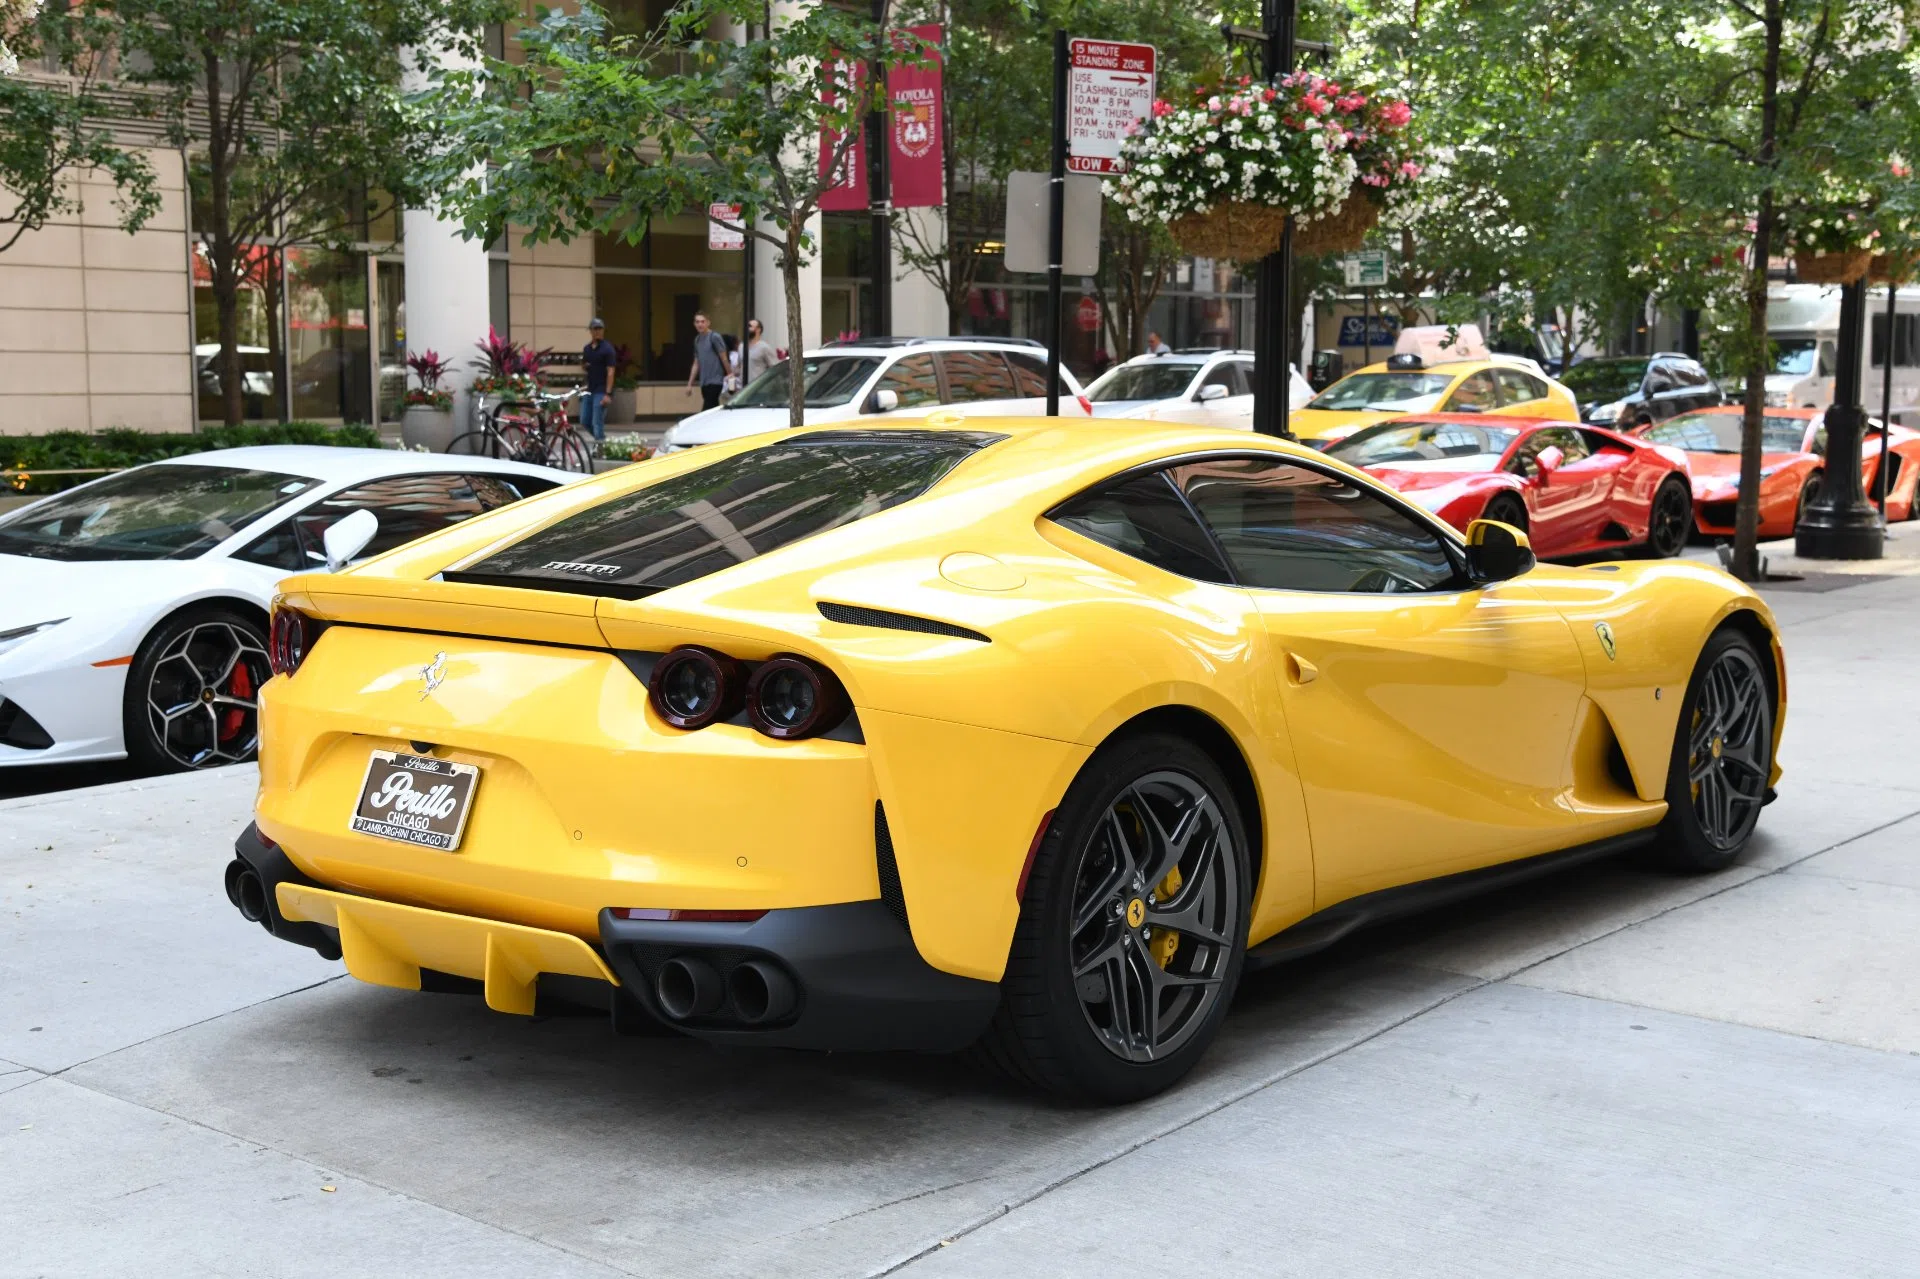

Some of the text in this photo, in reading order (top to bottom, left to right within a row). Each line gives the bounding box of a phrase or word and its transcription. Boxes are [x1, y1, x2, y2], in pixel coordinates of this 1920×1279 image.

[1076, 43, 1120, 57] 15 MINUTE
[1075, 55, 1146, 71] STANDING ZONE
[1075, 73, 1092, 83] USE
[896, 88, 934, 101] LOYOLA
[1074, 84, 1149, 99] FLASHING LIGHTS
[1074, 95, 1084, 105] 10
[1086, 96, 1100, 106] AM
[1108, 98, 1114, 107] 8
[1117, 98, 1130, 108] PM
[1074, 106, 1094, 116] MON
[1104, 108, 1134, 119] THURS
[1085, 117, 1098, 127] AM
[1107, 120, 1113, 129] 6
[1115, 120, 1128, 129] PM
[1073, 128, 1088, 138] FRI
[1097, 129, 1116, 140] SUN
[847, 150, 856, 189] WATER
[1073, 157, 1102, 171] TOW
[370, 771, 457, 820] Perillo
[387, 811, 430, 830] CHICAGO
[362, 820, 442, 846] LAMBORGHINI CHICAGO
